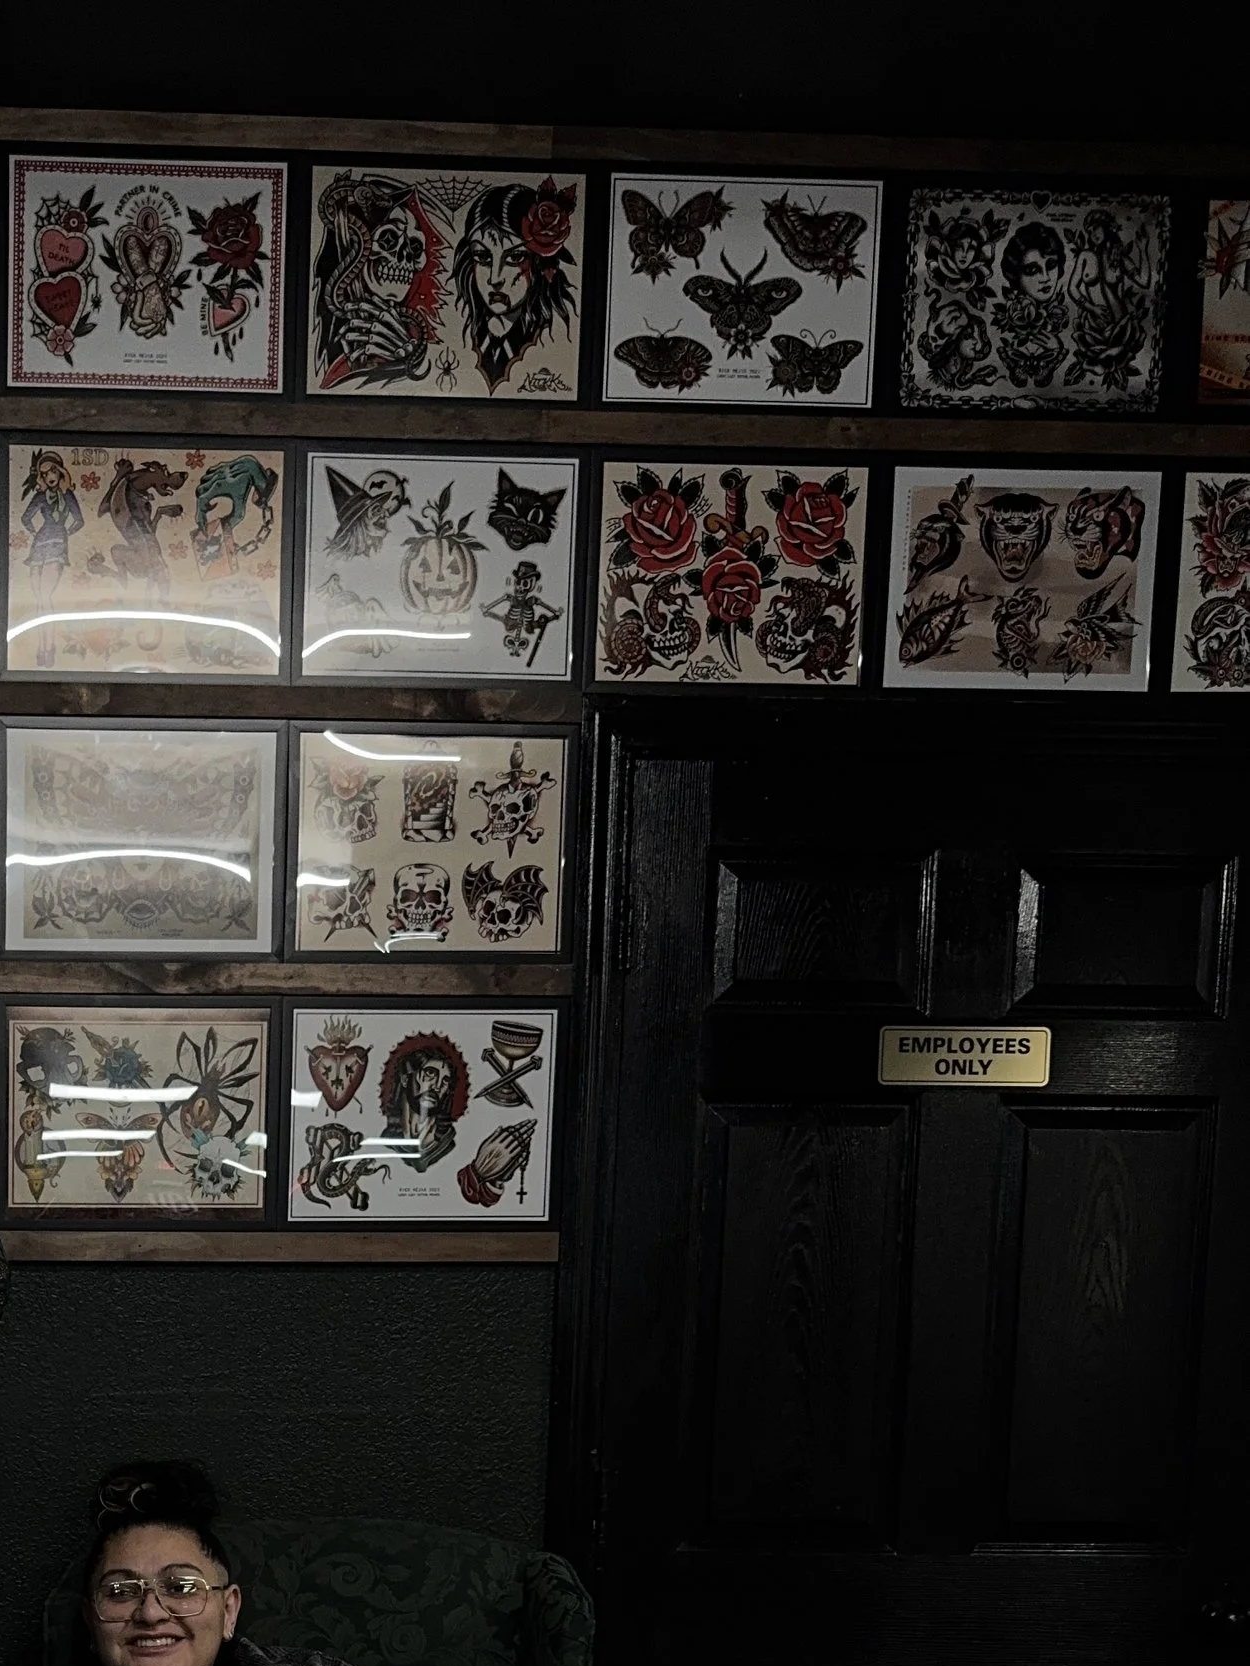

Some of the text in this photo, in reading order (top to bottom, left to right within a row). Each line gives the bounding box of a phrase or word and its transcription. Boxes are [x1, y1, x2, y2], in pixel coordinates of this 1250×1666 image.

[114, 185, 182, 217] PARTNER IN CRIME
[48, 252, 75, 264] DEATH
[199, 297, 209, 336] BE MINE
[899, 1037, 1031, 1054] EMPLOYEES
[935, 1058, 993, 1075] ONLY
